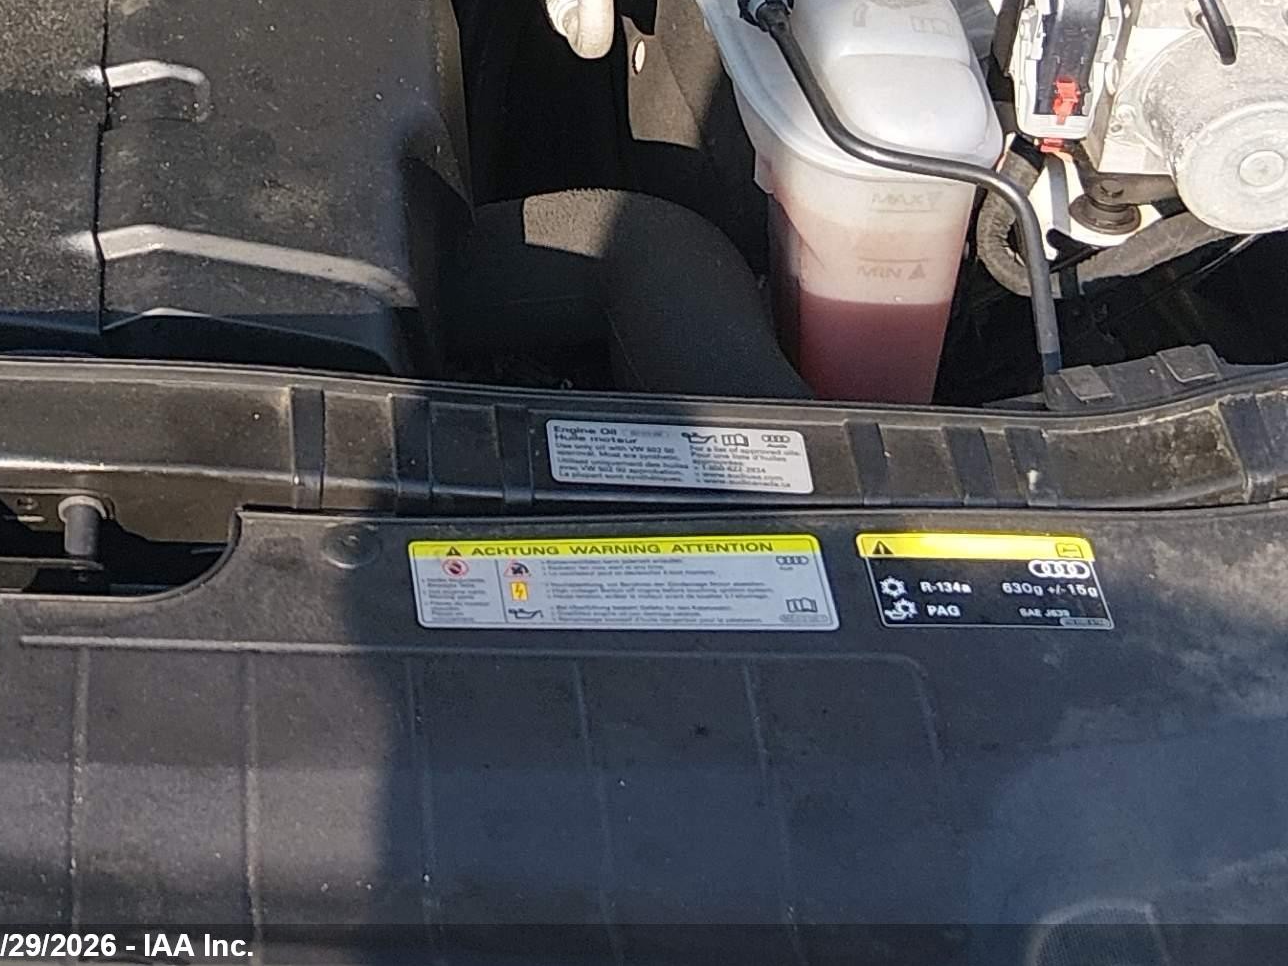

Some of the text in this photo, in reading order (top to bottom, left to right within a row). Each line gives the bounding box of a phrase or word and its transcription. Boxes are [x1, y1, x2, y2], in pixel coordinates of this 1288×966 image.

[871, 192, 923, 207] MAX
[857, 265, 902, 280] MIN
[553, 425, 617, 436] Engine Oil
[590, 436, 637, 444] moteur
[471, 541, 774, 557] ACHTUNG WARNING ATTENTION
[919, 581, 972, 594] R-134a
[1001, 582, 1044, 597] 630g
[926, 604, 961, 617] PAG
